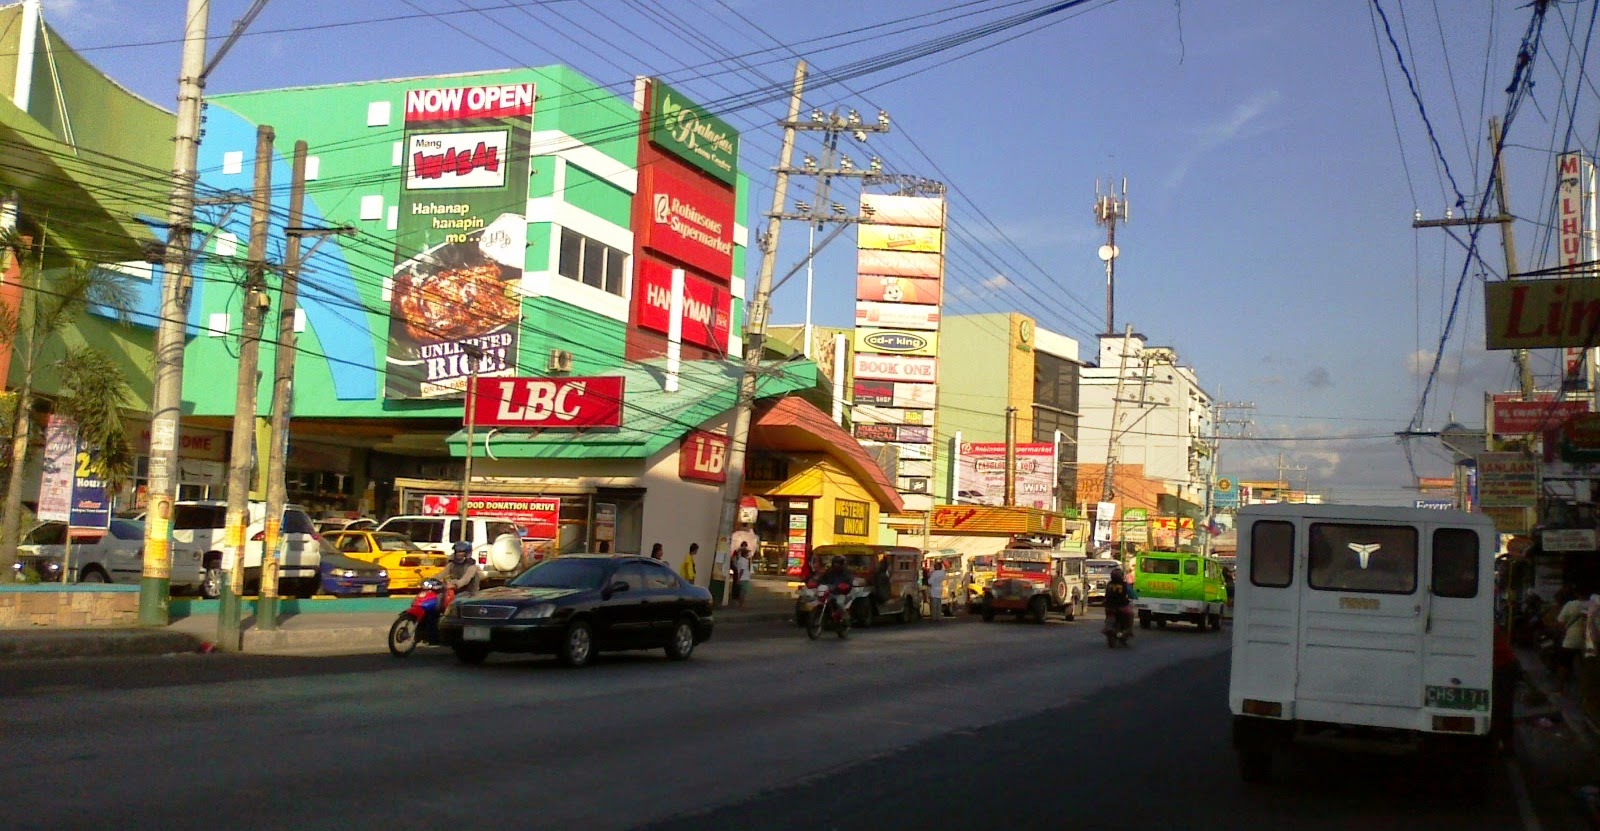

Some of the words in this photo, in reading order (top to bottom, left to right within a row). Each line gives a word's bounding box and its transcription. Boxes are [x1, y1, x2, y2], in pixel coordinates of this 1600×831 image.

[407, 89, 462, 112] NOW
[469, 84, 532, 110] OPEN
[415, 139, 442, 149] Mang
[412, 202, 470, 216] Hahanap
[671, 198, 722, 235] Robinsons
[432, 216, 484, 232] hanapin
[670, 216, 733, 255] Supermarket
[647, 283, 715, 327] HANYMAN
[895, 338, 920, 348] king
[427, 348, 507, 381] RICE!
[859, 360, 899, 375] BOOK
[903, 364, 931, 376] ONE
[497, 381, 585, 421] LBC
[694, 436, 727, 473] LB
[1015, 446, 1052, 454] permarket
[1023, 483, 1048, 493] WIN
[467, 501, 484, 510] OOD
[486, 502, 528, 511] DONATION
[530, 503, 555, 511] DRIVE
